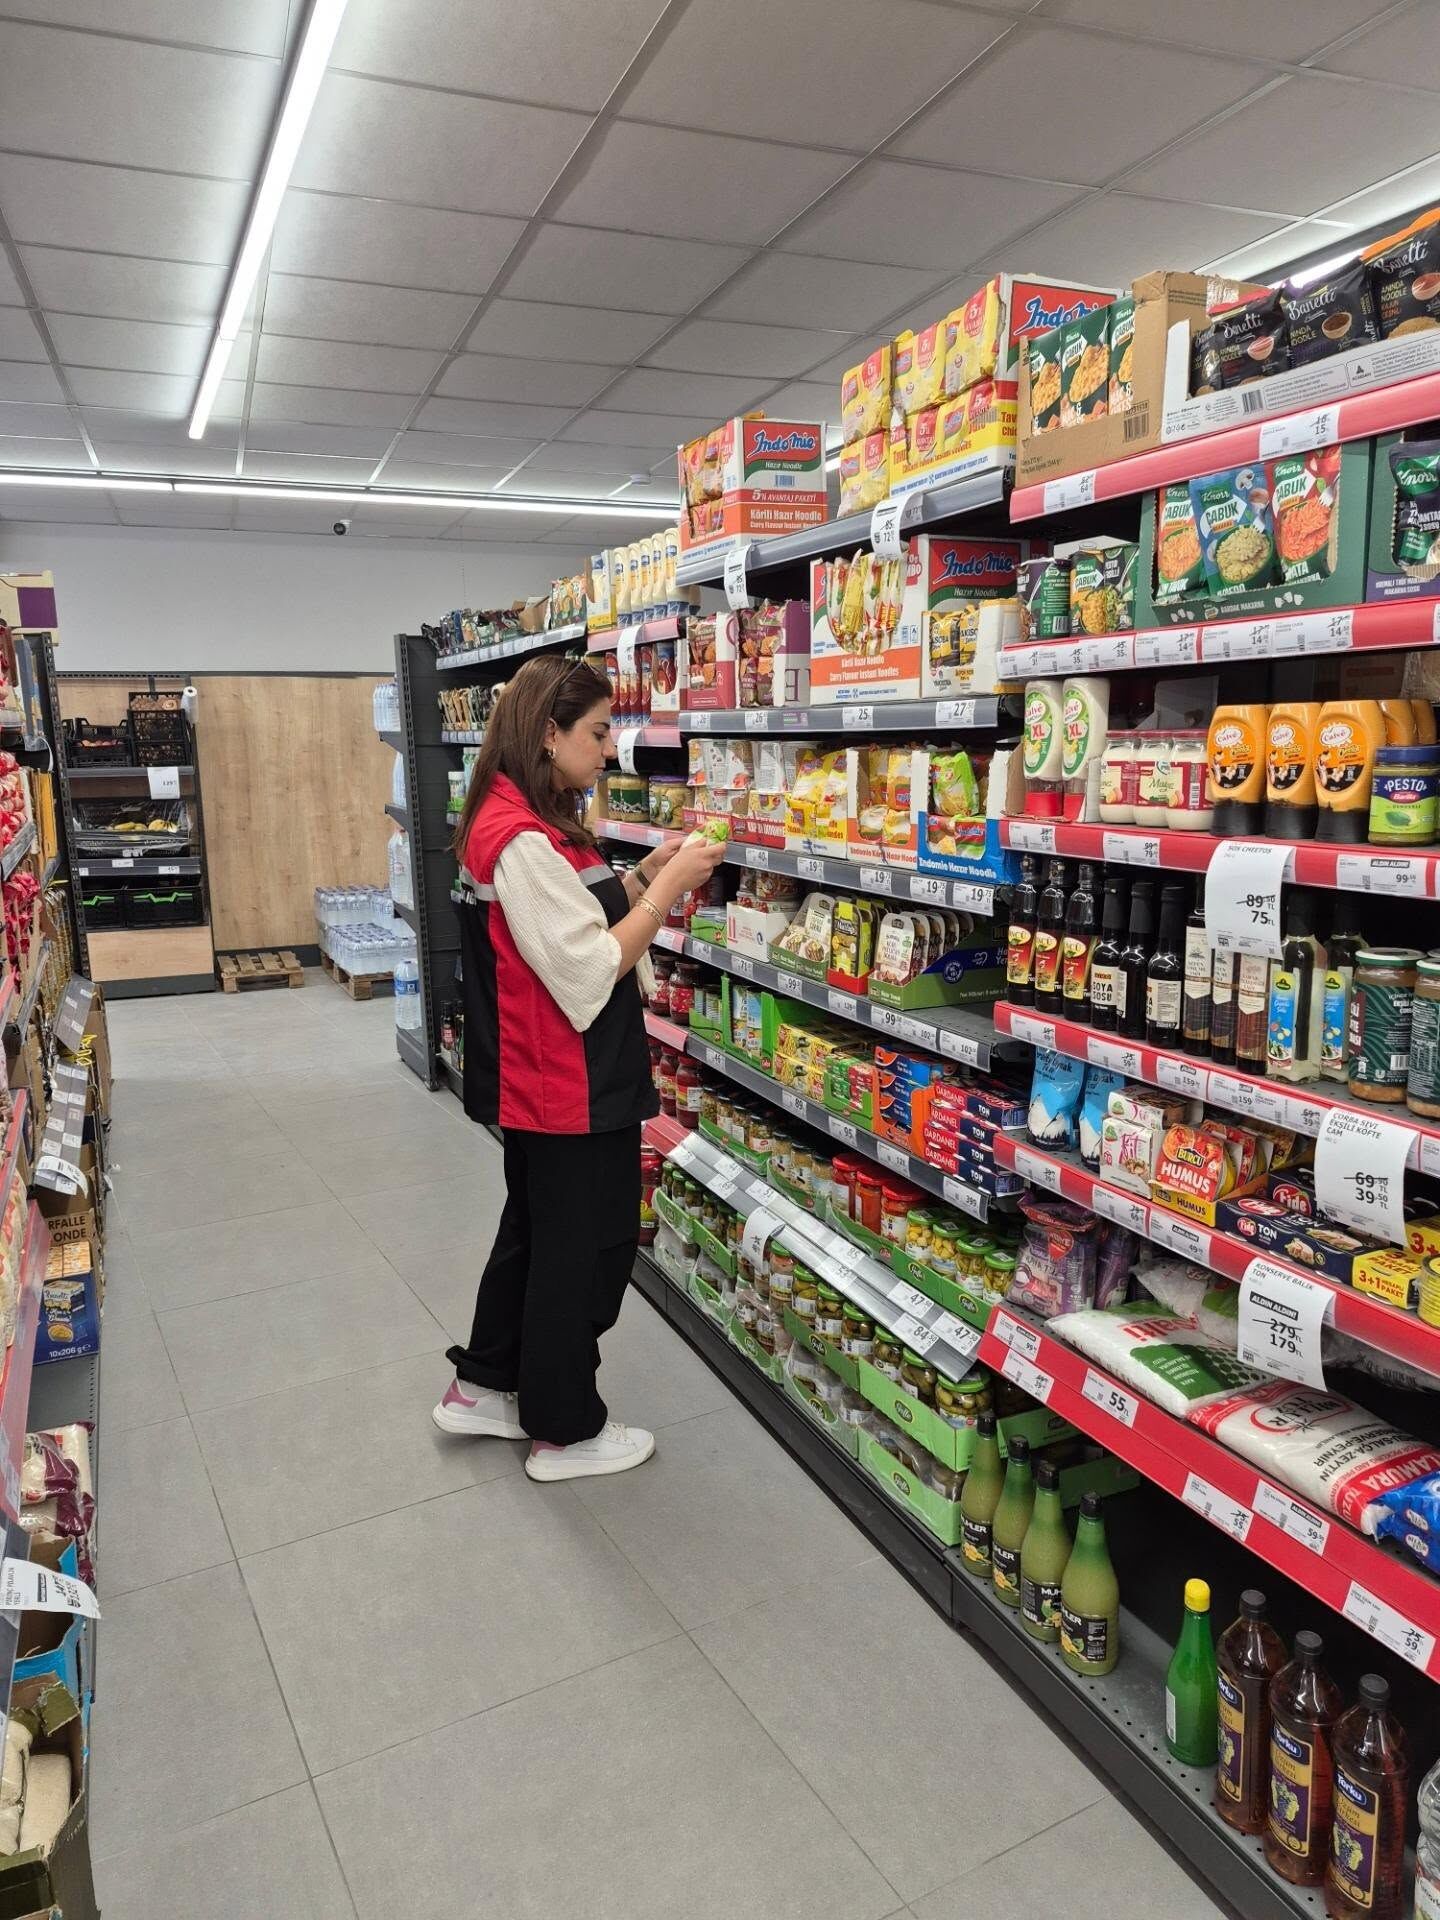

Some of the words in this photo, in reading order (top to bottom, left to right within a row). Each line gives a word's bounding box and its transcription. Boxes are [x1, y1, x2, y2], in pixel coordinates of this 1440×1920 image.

[1013, 296, 1100, 336] Indom
[746, 430, 816, 459] Indomie
[1275, 462, 1302, 476] Knorr
[1397, 470, 1438, 486] Knorr
[750, 509, 773, 519] Körili
[773, 510, 793, 520] Hazır
[794, 510, 822, 521] Noodle
[933, 549, 1014, 584] Indomie
[973, 588, 998, 598] Noodle
[858, 708, 868, 720] 25
[1032, 723, 1045, 738] XL
[1068, 723, 1082, 737] XL
[1385, 778, 1427, 792] PESTO
[899, 851, 917, 863] Nood
[1241, 846, 1273, 854] CHEETOS
[918, 857, 949, 872] Indomie
[969, 865, 997, 880] Noodle
[1251, 910, 1268, 925] 75
[1092, 981, 1113, 994] SOYA
[1092, 992, 1112, 1001] SOSU
[885, 1011, 896, 1025] 99
[936, 1085, 966, 1107] DARDANEL
[978, 1104, 990, 1115] TON
[932, 1108, 958, 1128] ARDANEL
[972, 1127, 985, 1138] TON
[924, 1127, 956, 1149] DARDANEL
[971, 1149, 984, 1161] TON
[925, 1147, 957, 1170] DARDANEL
[970, 1169, 983, 1182] TON
[1177, 1148, 1204, 1167] BURCU
[1160, 1161, 1210, 1194] HUMUS
[1177, 1197, 1206, 1216] HUMUS
[48, 1215, 86, 1230] RFALLE
[1258, 1222, 1278, 1241] TON
[1252, 1268, 1267, 1279] TON
[1255, 1262, 1290, 1282] KONSERVE
[1358, 1270, 1381, 1290] 3+1
[1381, 1285, 1404, 1299] PAKET
[1252, 1294, 1273, 1309] ALDIN
[1270, 1318, 1296, 1339] 279
[1270, 1333, 1296, 1353] 179
[1109, 1391, 1126, 1412] 55
[1360, 1452, 1440, 1490] LAMURA
[1041, 1587, 1062, 1597] MUH
[1405, 1636, 1418, 1650] 59
[1275, 1727, 1297, 1754] Torku
[1337, 1773, 1363, 1800] Torku
